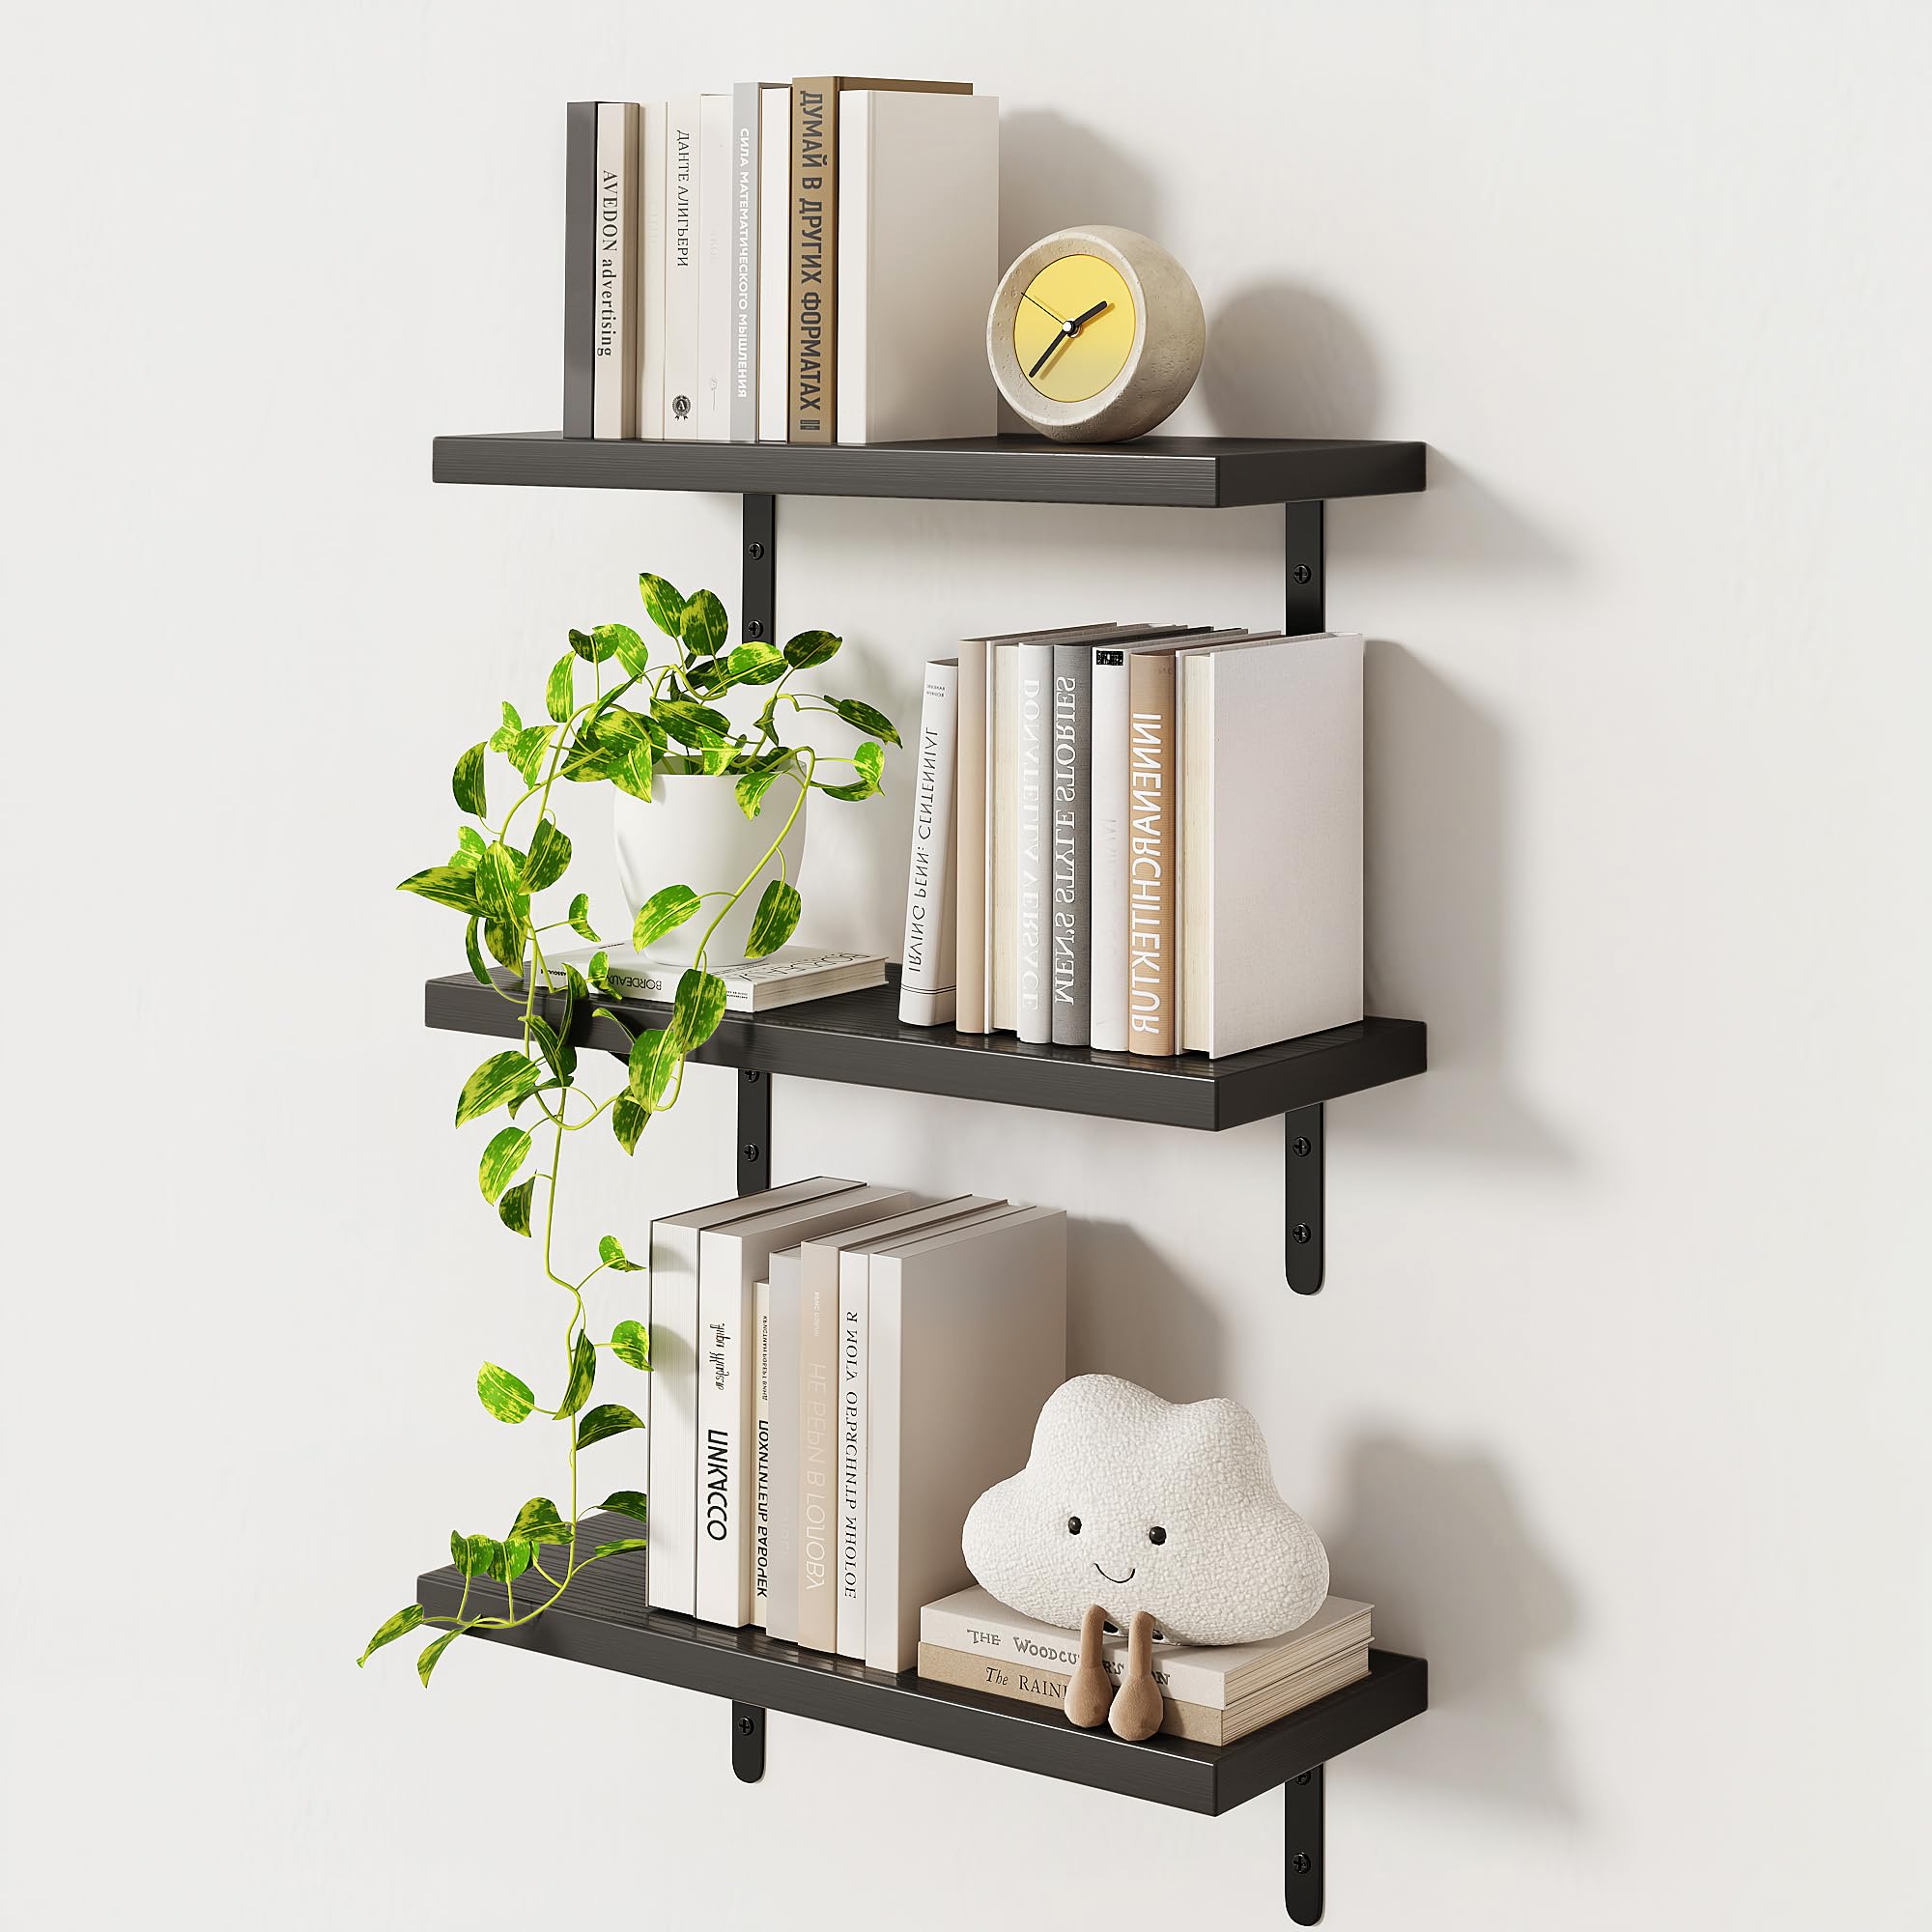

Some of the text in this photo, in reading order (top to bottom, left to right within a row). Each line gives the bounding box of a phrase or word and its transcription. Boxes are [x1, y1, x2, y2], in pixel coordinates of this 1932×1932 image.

[800, 91, 827, 167] ДУМАЙ
[677, 130, 689, 266] ДАНТЕ АЛИГЬЕРИ
[803, 178, 822, 189] В
[598, 170, 617, 356] AVEDON advertising
[737, 128, 750, 398] СИЛА МАТЕМАТИЧЕСКОГО МЫШЛЕНИЯ
[799, 198, 822, 284] ДРУГИХ
[800, 293, 821, 411] ФОРМАТАХ
[607, 976, 662, 990] BORDEAUX
[967, 1630, 1001, 1645] THE
[986, 1667, 1008, 1685] The
